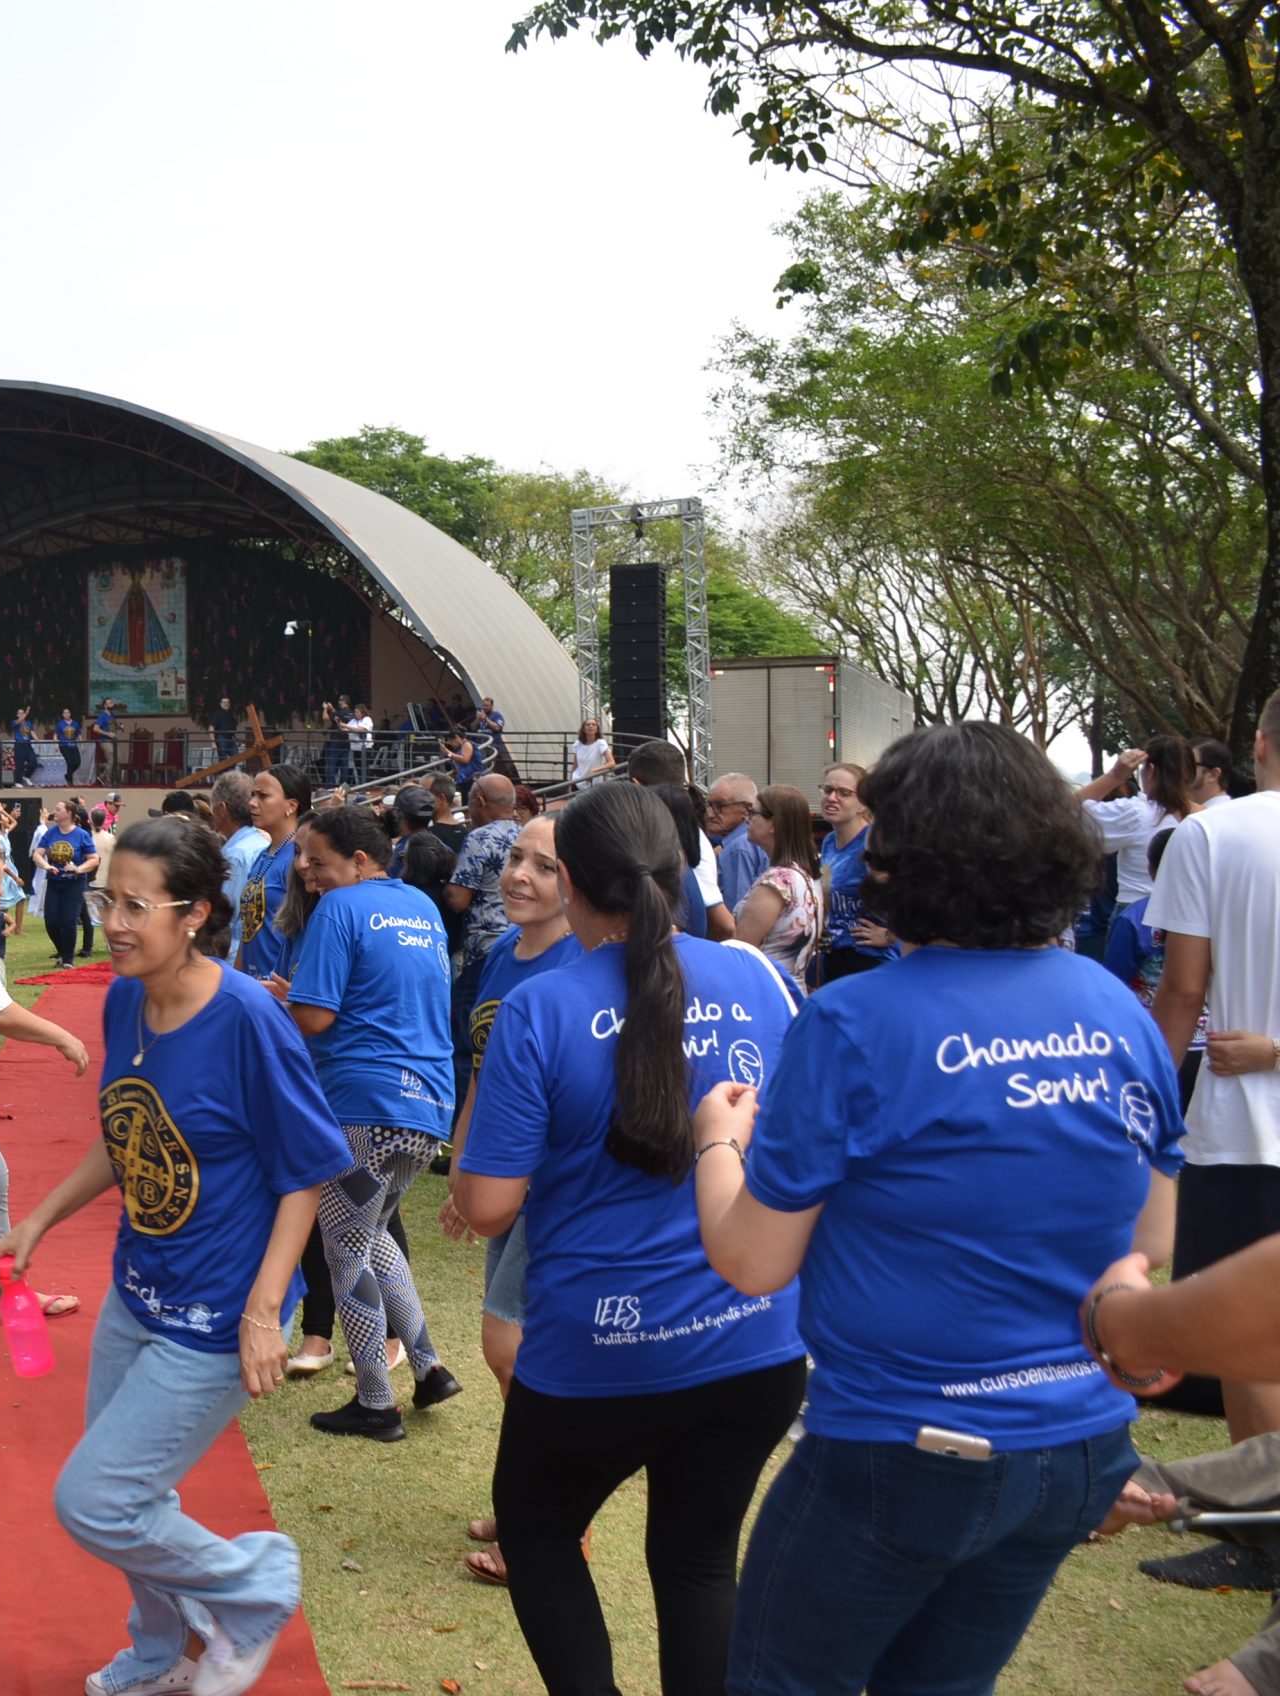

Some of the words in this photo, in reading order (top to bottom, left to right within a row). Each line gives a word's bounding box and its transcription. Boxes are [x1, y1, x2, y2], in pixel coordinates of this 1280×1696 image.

[369, 912, 432, 931] Chamado
[397, 930, 435, 949] Servir!
[731, 1002, 753, 1022] a
[681, 1029, 720, 1059] vir!
[936, 1021, 1113, 1074] Chamado
[1005, 1067, 1111, 1108] Servir!
[592, 1331, 640, 1346] Instituto
[691, 1316, 705, 1332] do
[741, 1295, 773, 1317] Santo
[593, 1295, 642, 1331] IEES
